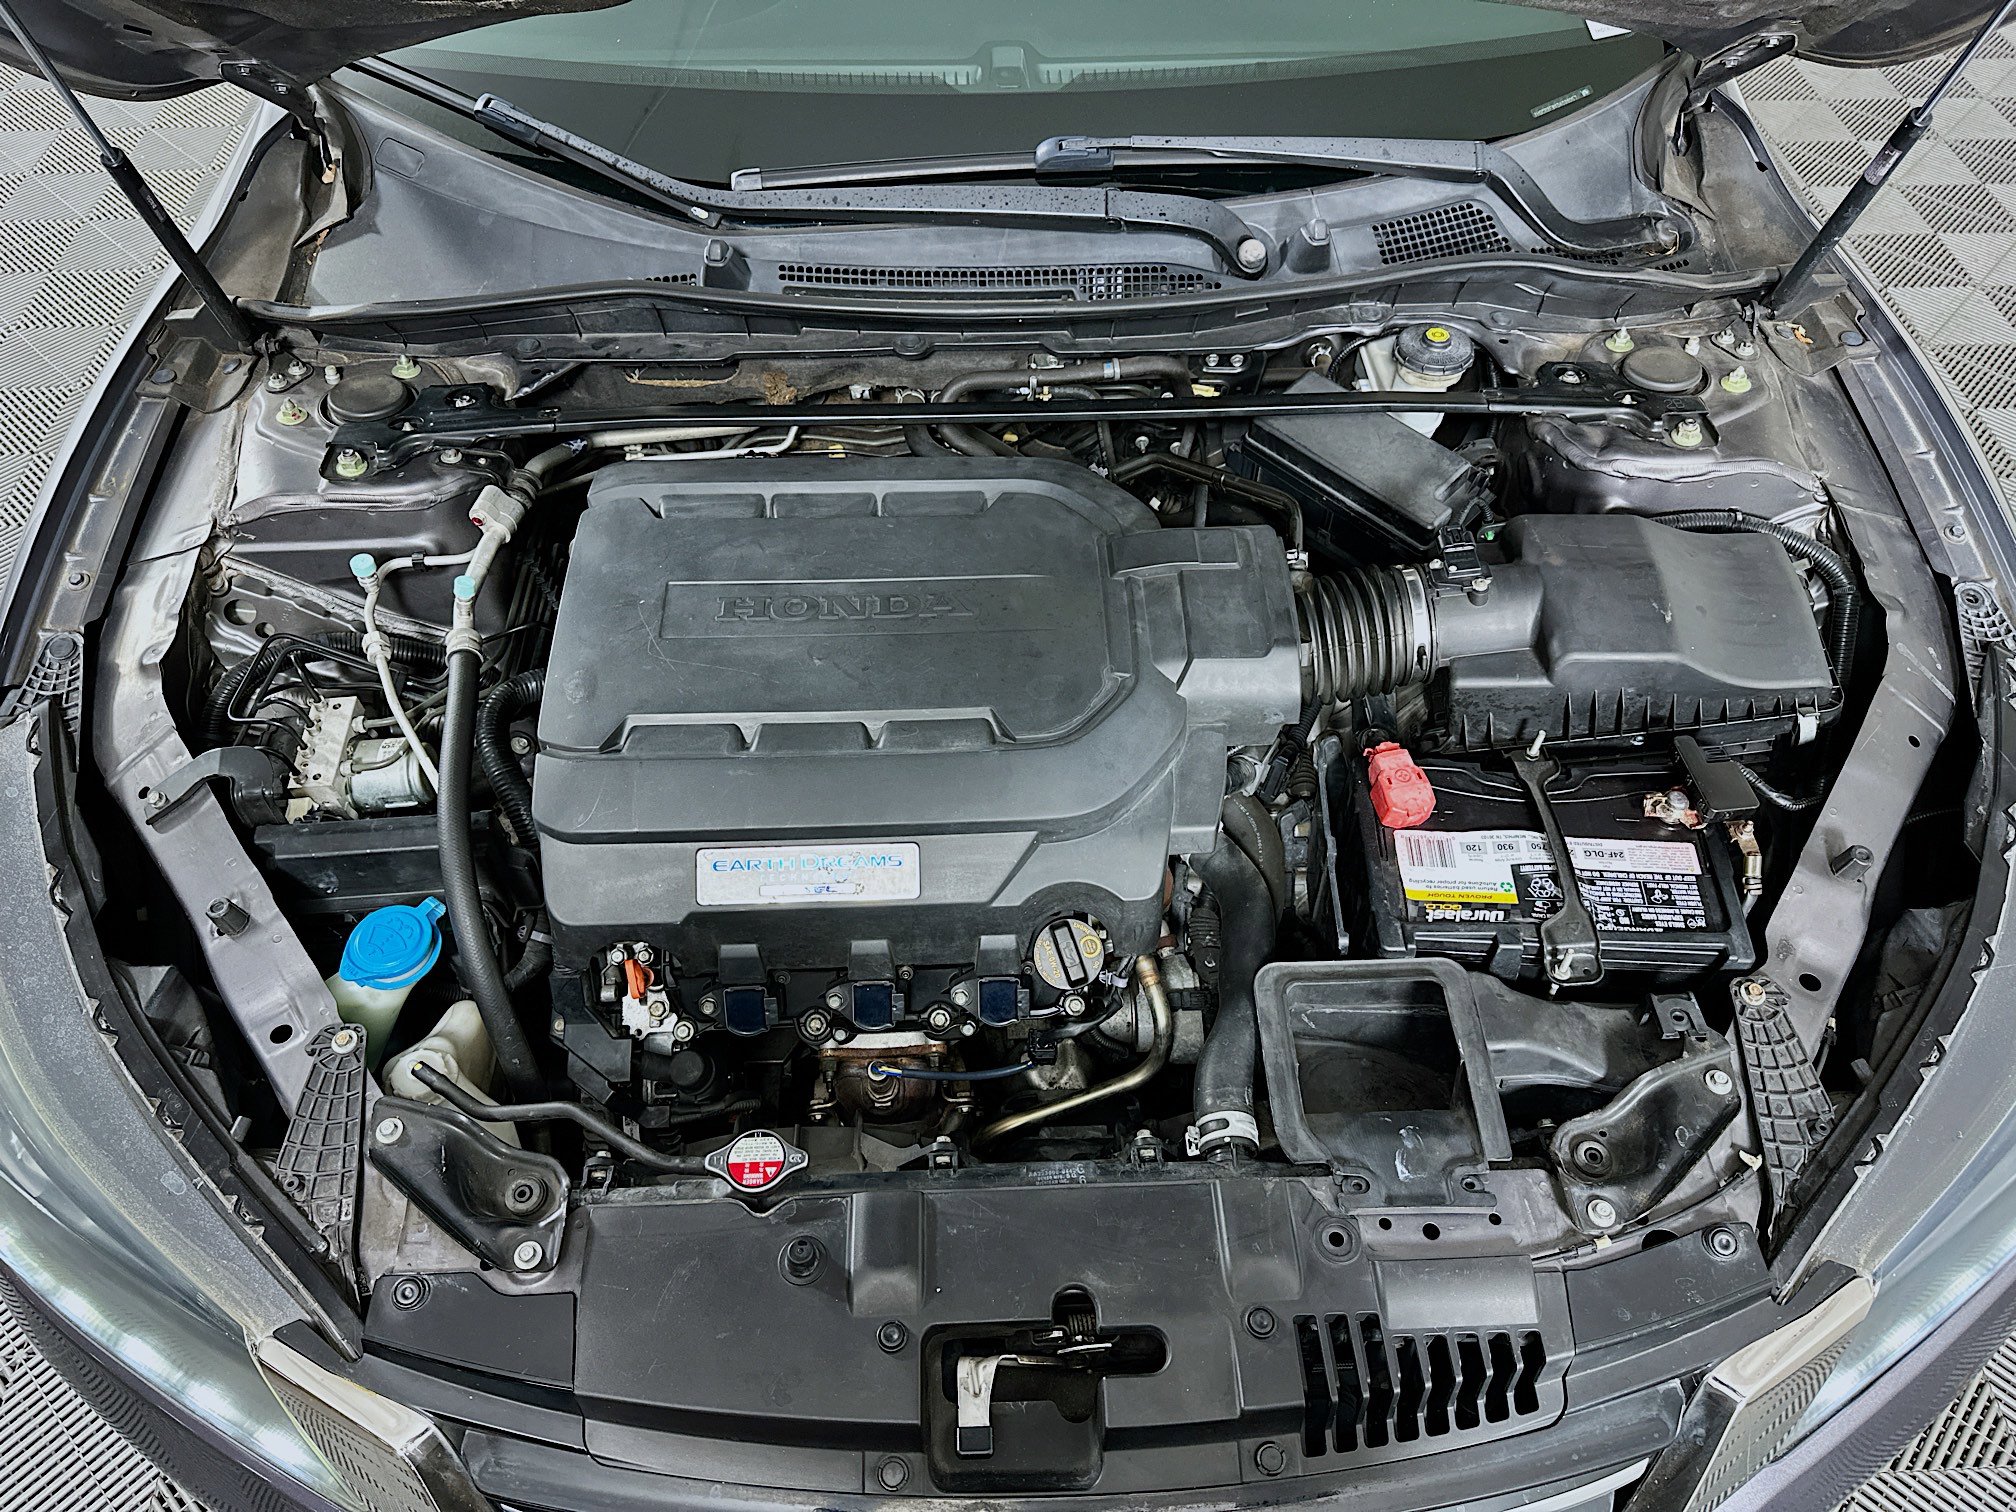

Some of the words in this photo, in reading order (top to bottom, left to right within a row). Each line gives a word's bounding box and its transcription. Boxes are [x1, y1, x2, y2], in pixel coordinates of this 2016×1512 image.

[715, 594, 973, 622] HONDA
[1497, 843, 1514, 851] 930
[1584, 849, 1625, 859] 24F-DLG
[712, 855, 795, 872] EARTH
[800, 853, 903, 871] DREAMS
[1425, 910, 1508, 923] Duralast
[1043, 940, 1053, 956] SAE
